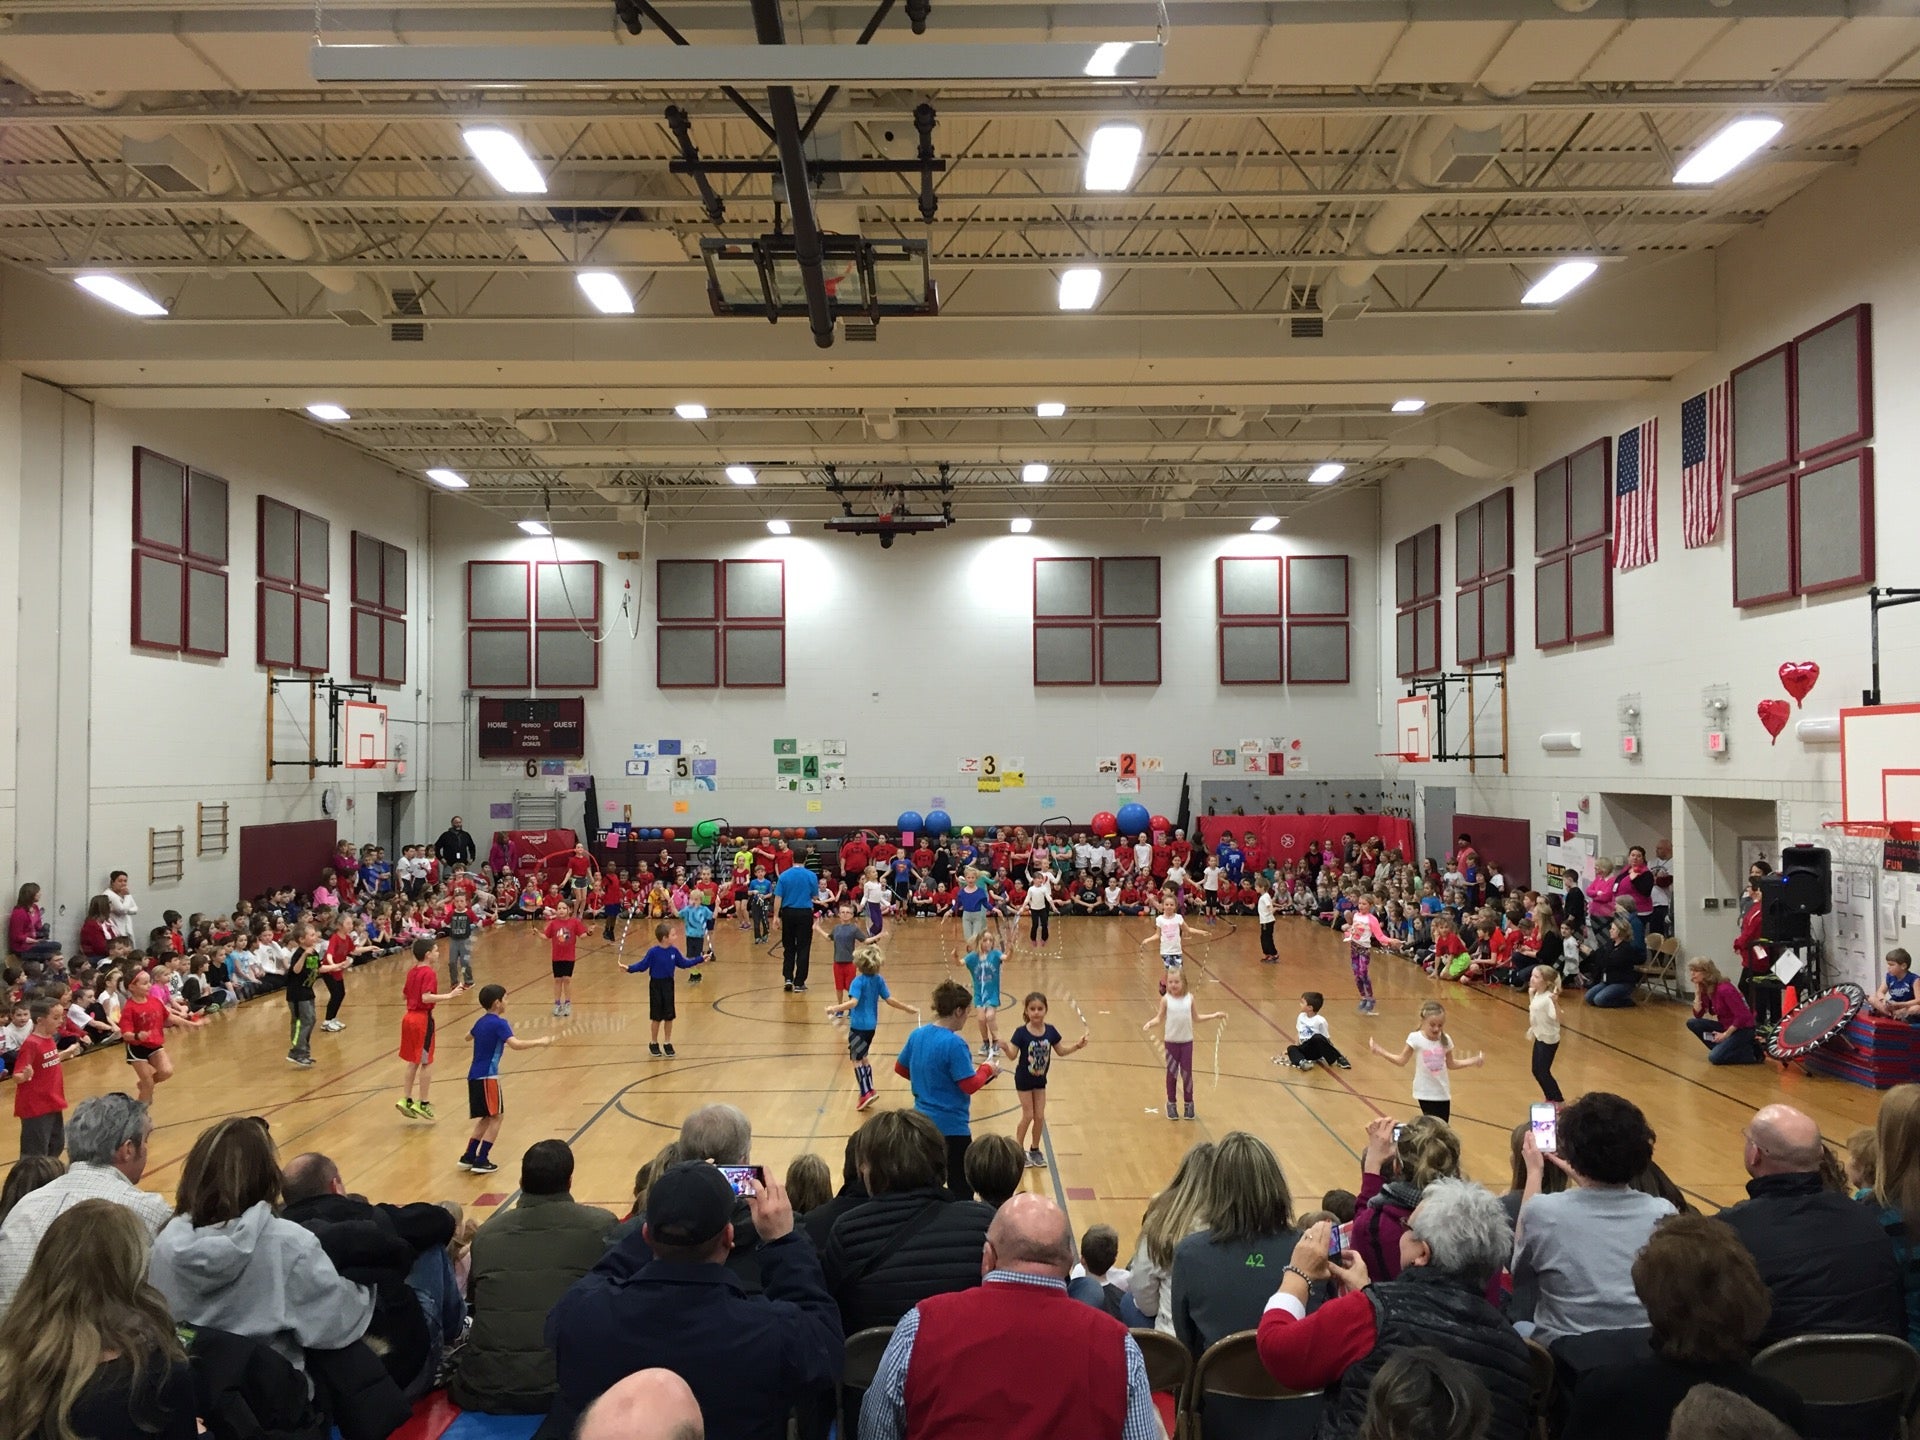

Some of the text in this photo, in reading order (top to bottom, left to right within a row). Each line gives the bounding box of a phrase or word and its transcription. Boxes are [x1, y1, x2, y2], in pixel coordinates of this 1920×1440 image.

[487, 721, 508, 729] HOME
[526, 758, 538, 778] 6
[677, 757, 688, 777] 5
[803, 756, 816, 776] 4
[984, 755, 996, 775] 3
[1123, 754, 1135, 775] 2
[1271, 756, 1281, 775] 1
[1885, 859, 1903, 872] FUN
[1245, 1253, 1265, 1268] 42
